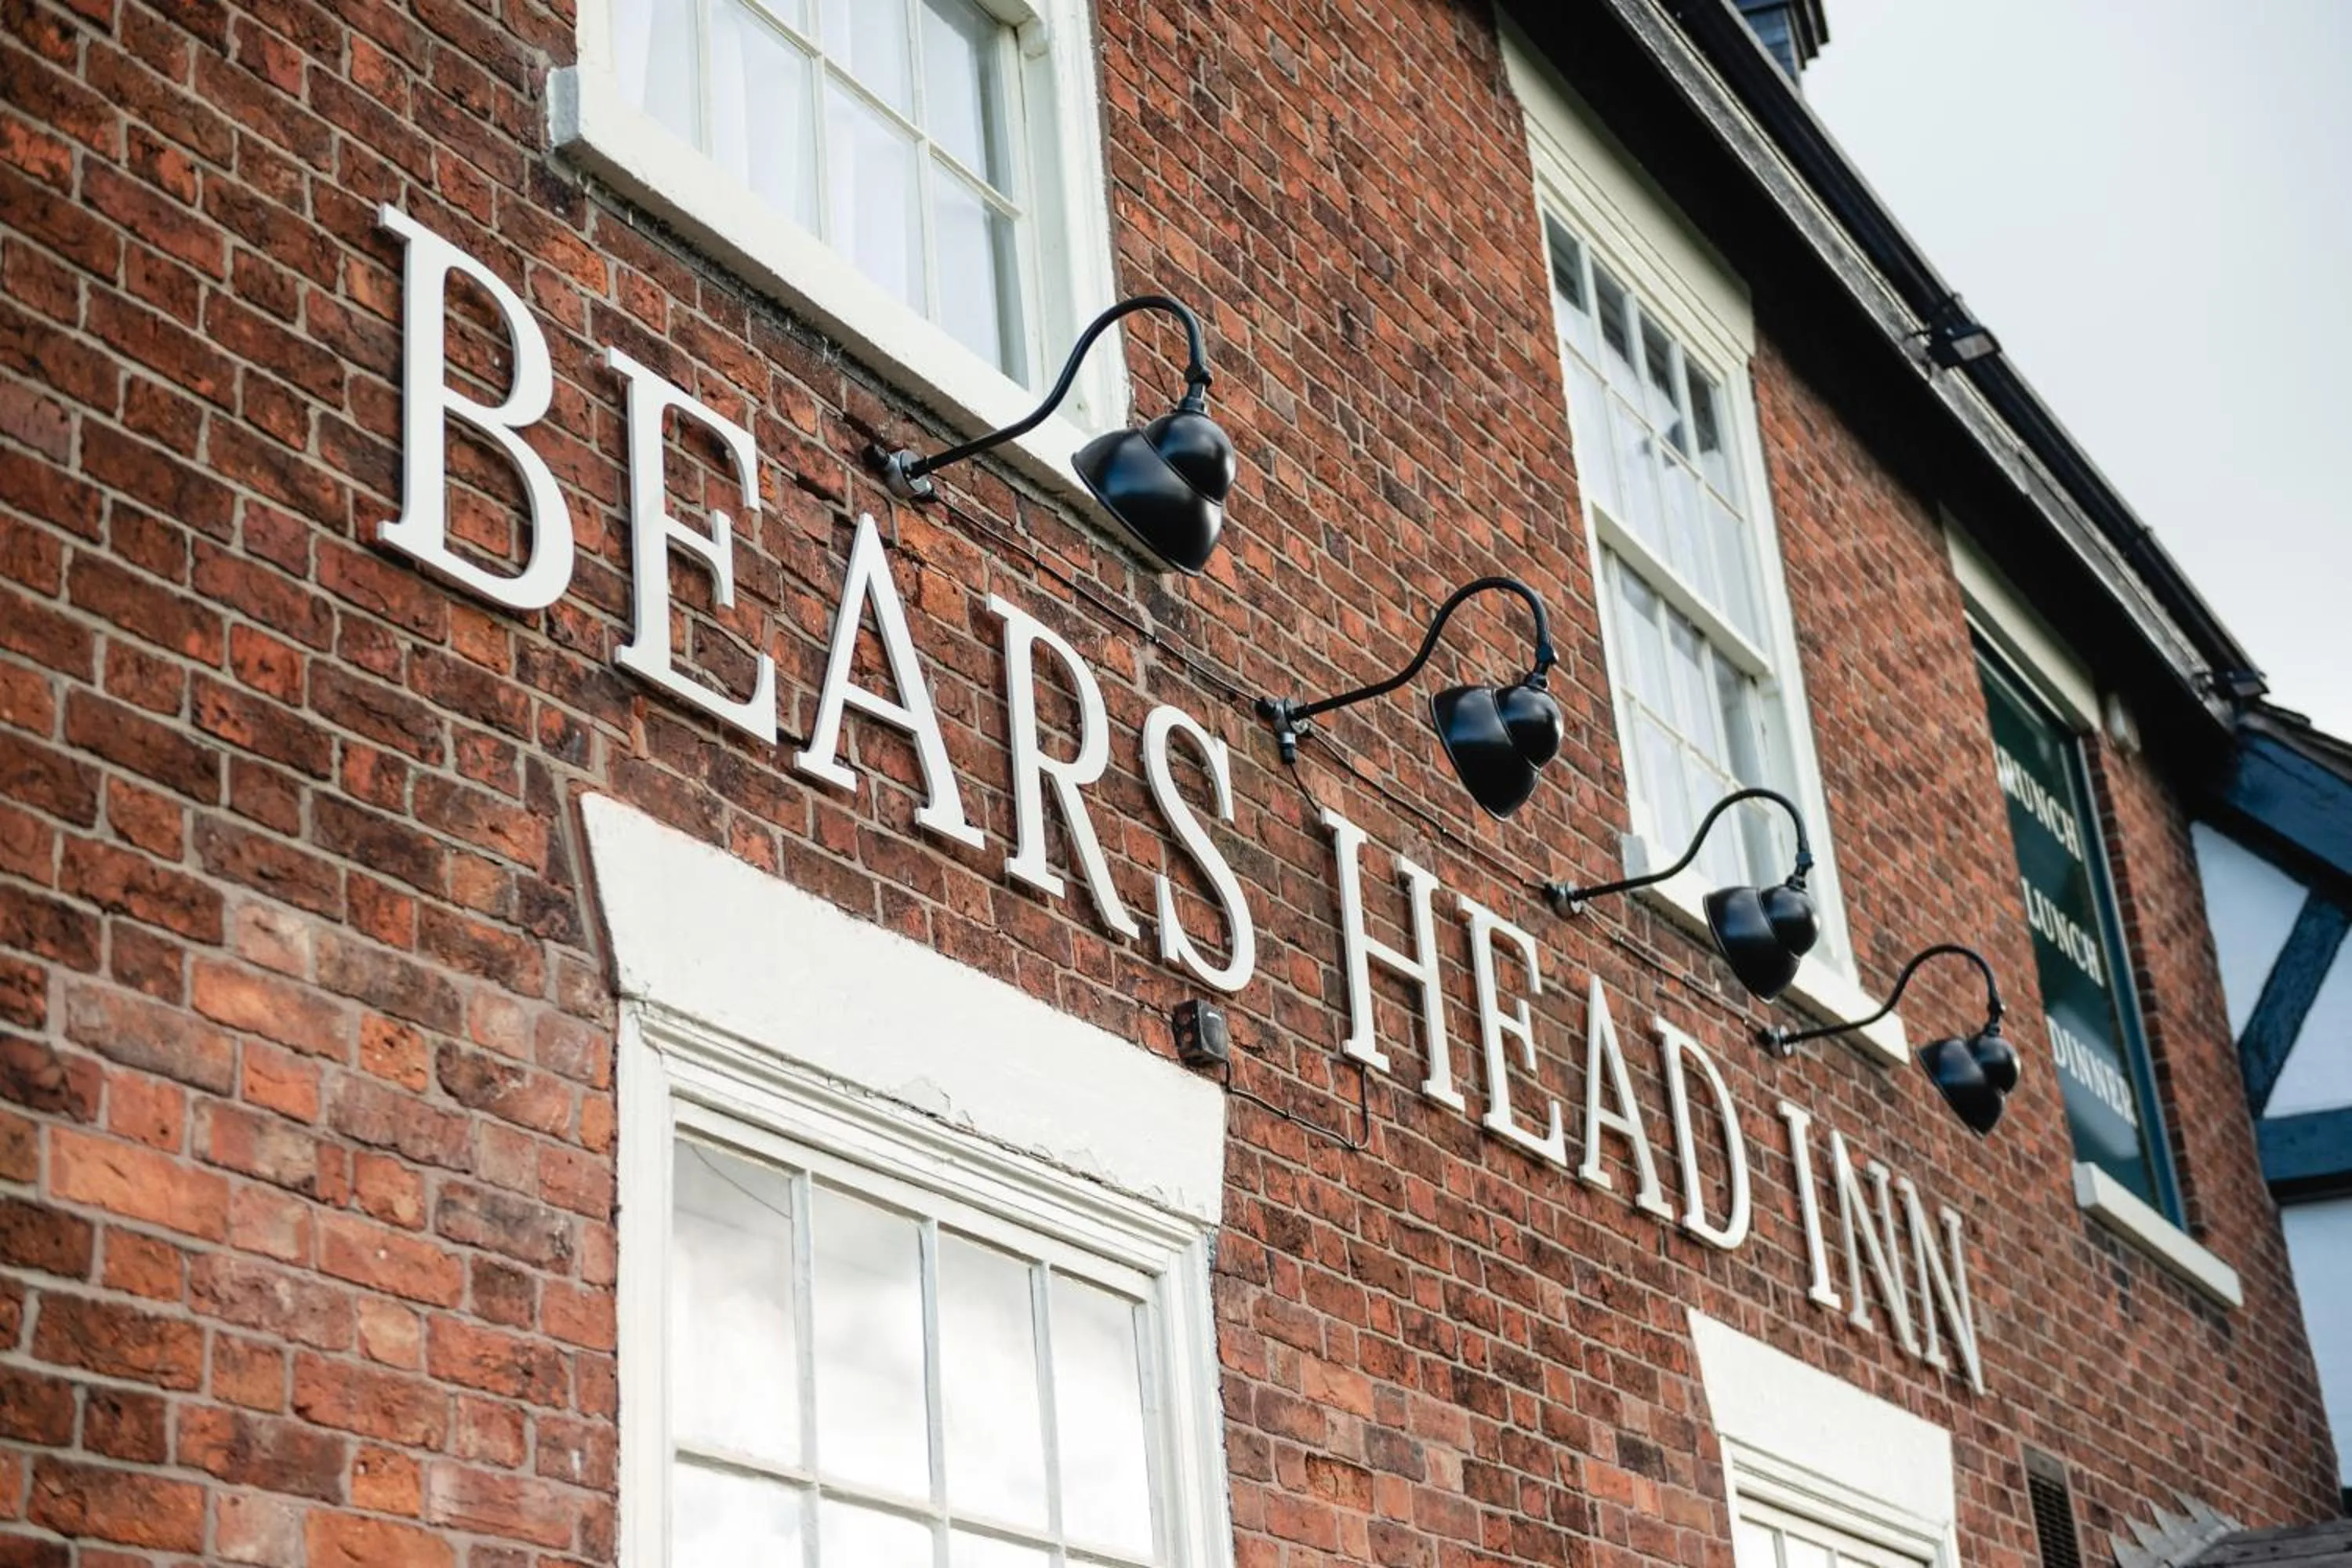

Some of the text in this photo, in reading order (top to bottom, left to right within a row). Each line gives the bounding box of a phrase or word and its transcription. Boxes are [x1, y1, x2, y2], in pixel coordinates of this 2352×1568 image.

[378, 203, 1984, 1394] BEARS HEAD INN
[1994, 745, 2082, 862] RUNCH
[2021, 876, 2103, 988] LUNCH
[2045, 1014, 2138, 1127] DINNER
